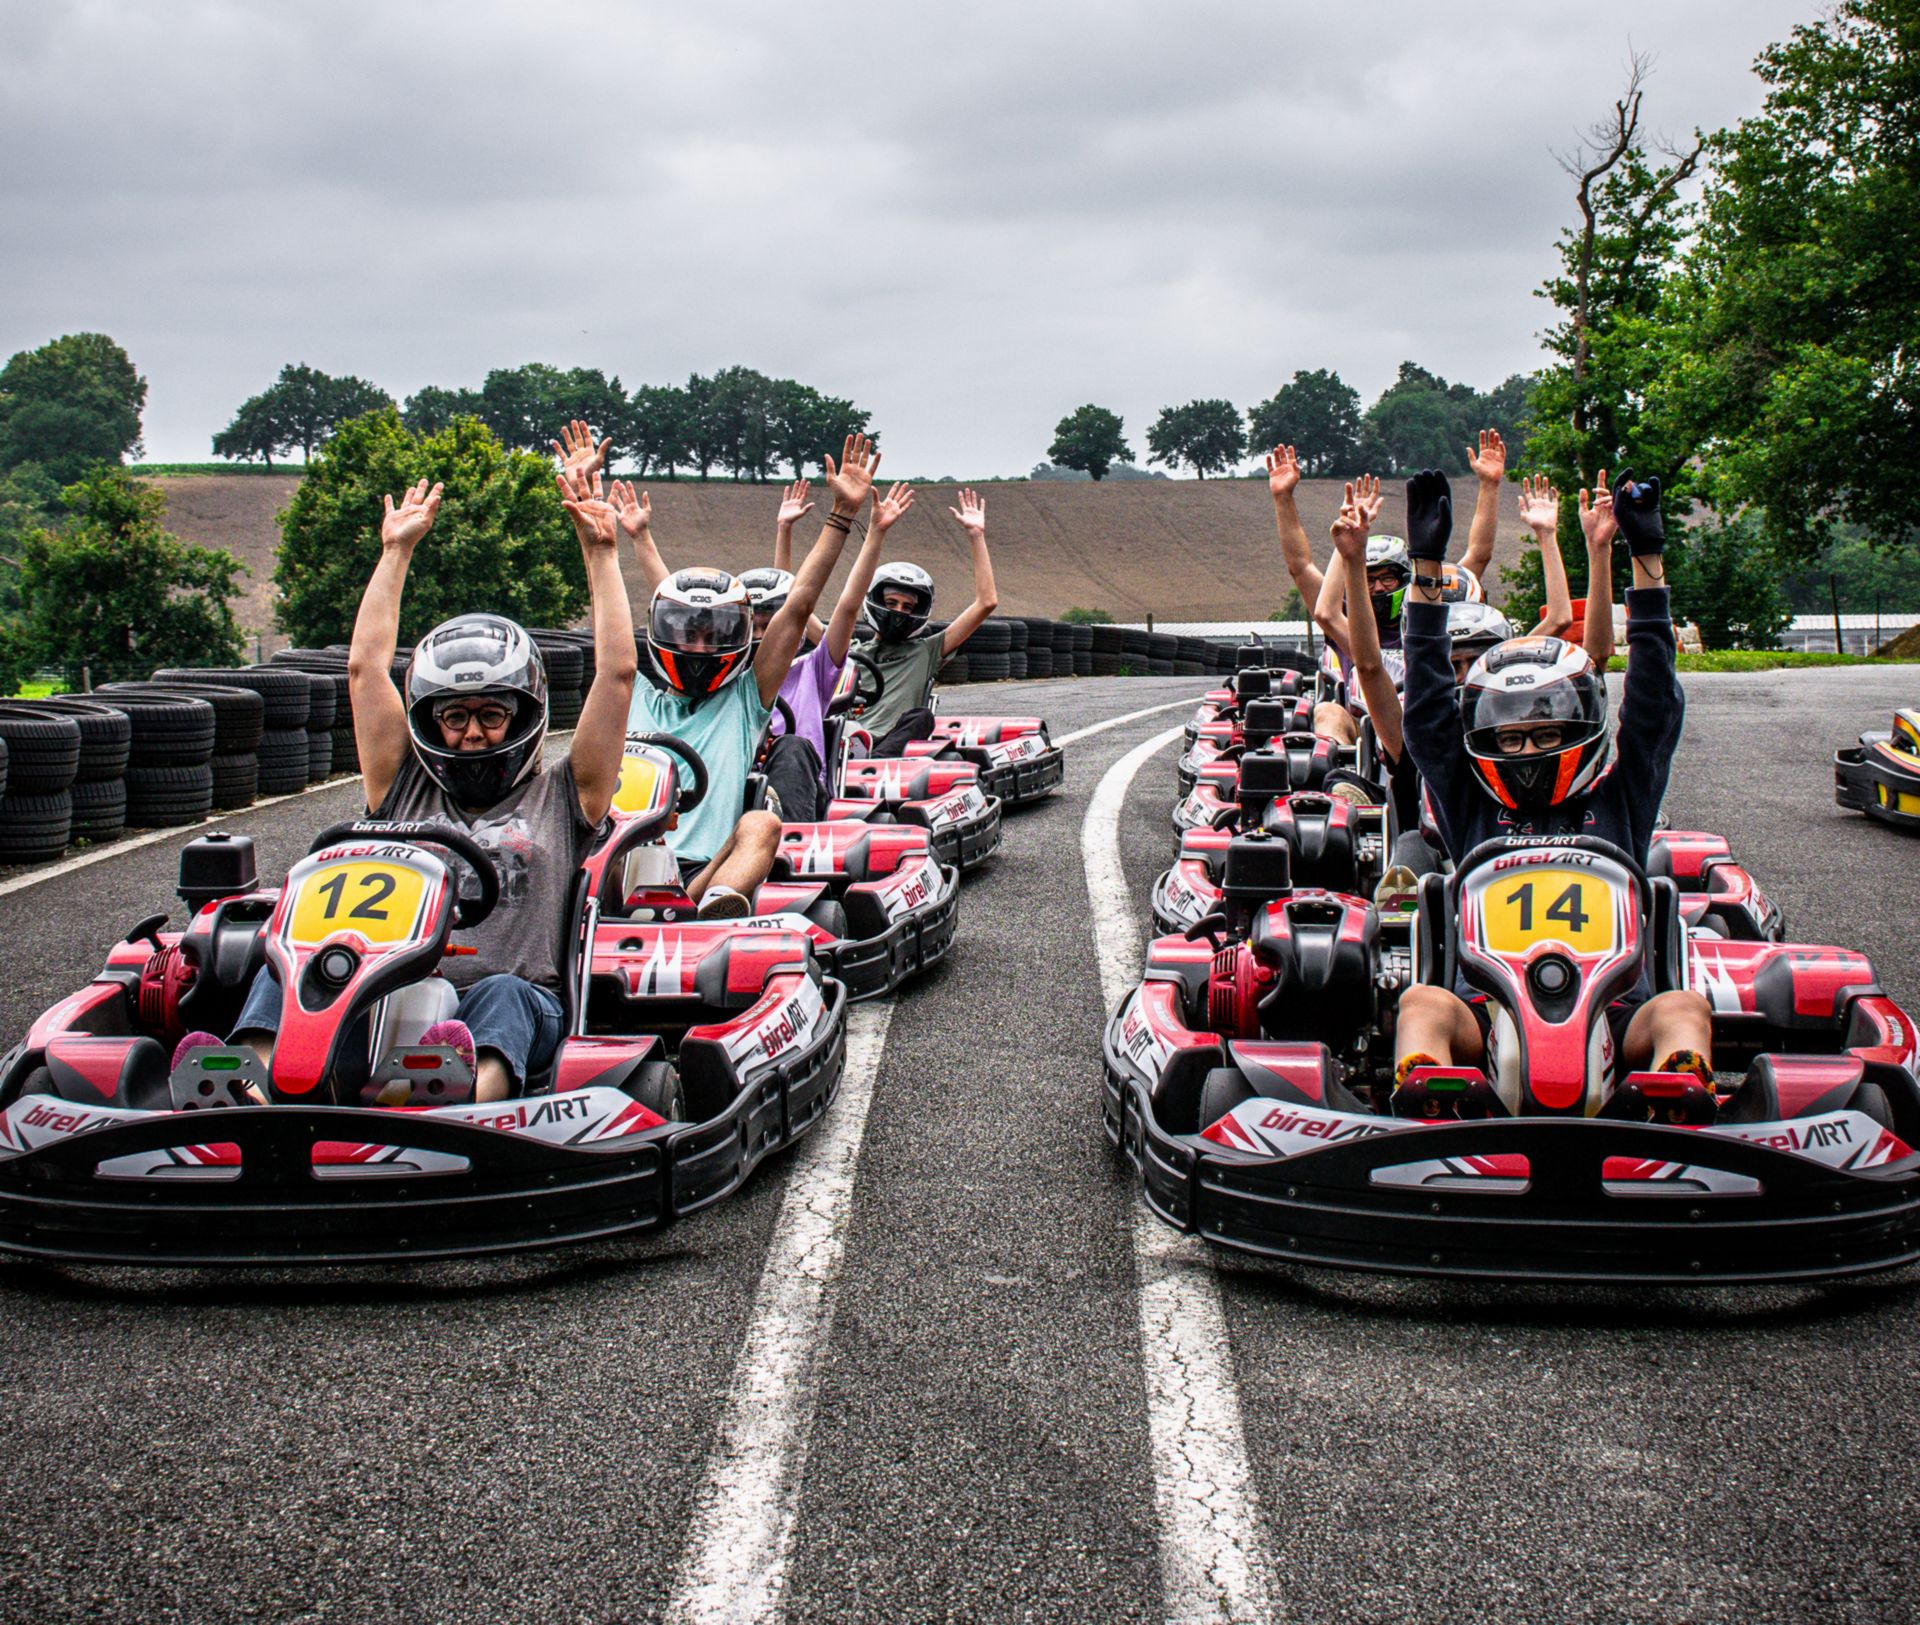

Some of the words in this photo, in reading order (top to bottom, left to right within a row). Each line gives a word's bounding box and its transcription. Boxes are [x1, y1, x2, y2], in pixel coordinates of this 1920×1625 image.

[690, 595, 712, 604] BOXS
[454, 671, 485, 683] BOXS
[1505, 674, 1536, 687] BOXS
[351, 820, 425, 833] birelART
[1504, 834, 1582, 846] birelART
[316, 844, 422, 863] birelART
[1493, 851, 1602, 872] birelART
[318, 871, 396, 920] 12
[1506, 882, 1589, 933] 14
[757, 997, 810, 1059] birelART
[21, 1103, 124, 1136] birelA
[1259, 1107, 1390, 1141] birelA
